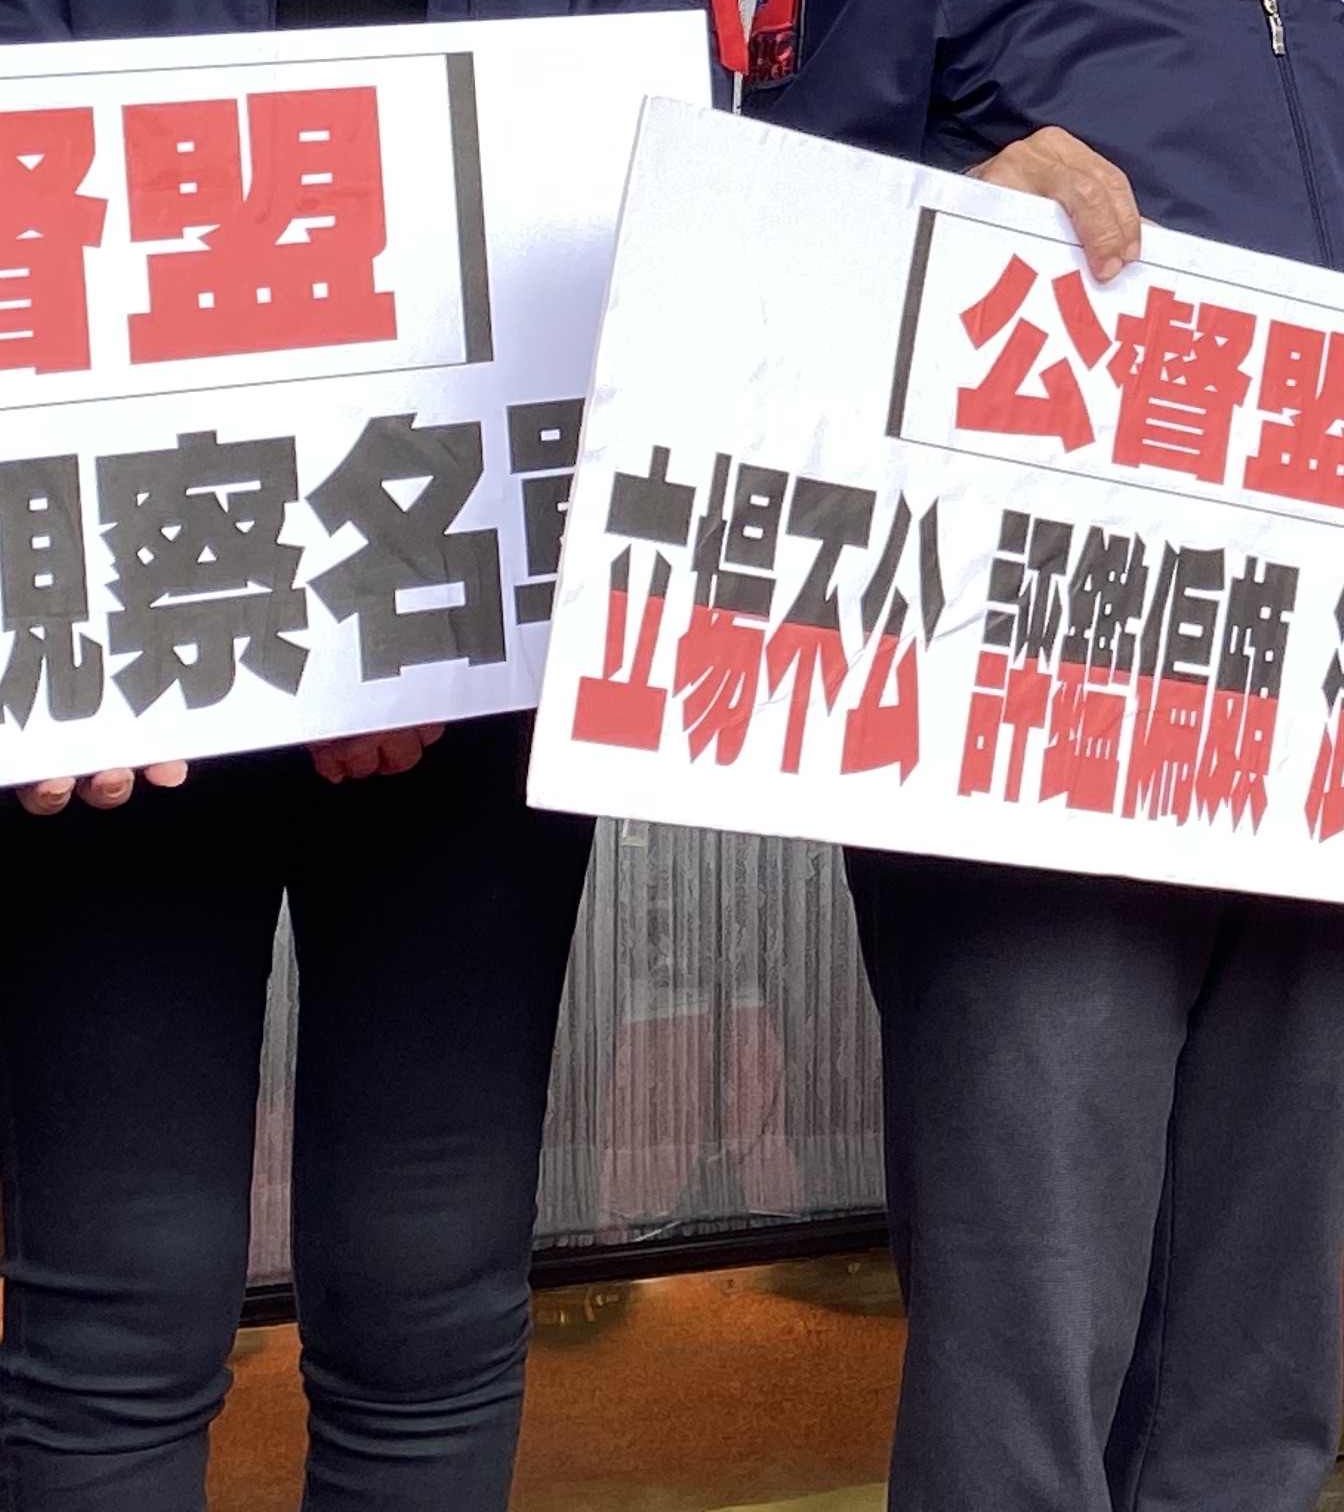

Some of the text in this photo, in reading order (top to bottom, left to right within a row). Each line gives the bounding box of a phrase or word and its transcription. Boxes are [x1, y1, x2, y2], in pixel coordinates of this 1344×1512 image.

[572, 446, 945, 786] 立場不公
[957, 510, 1299, 835] 評鑑偏頗
